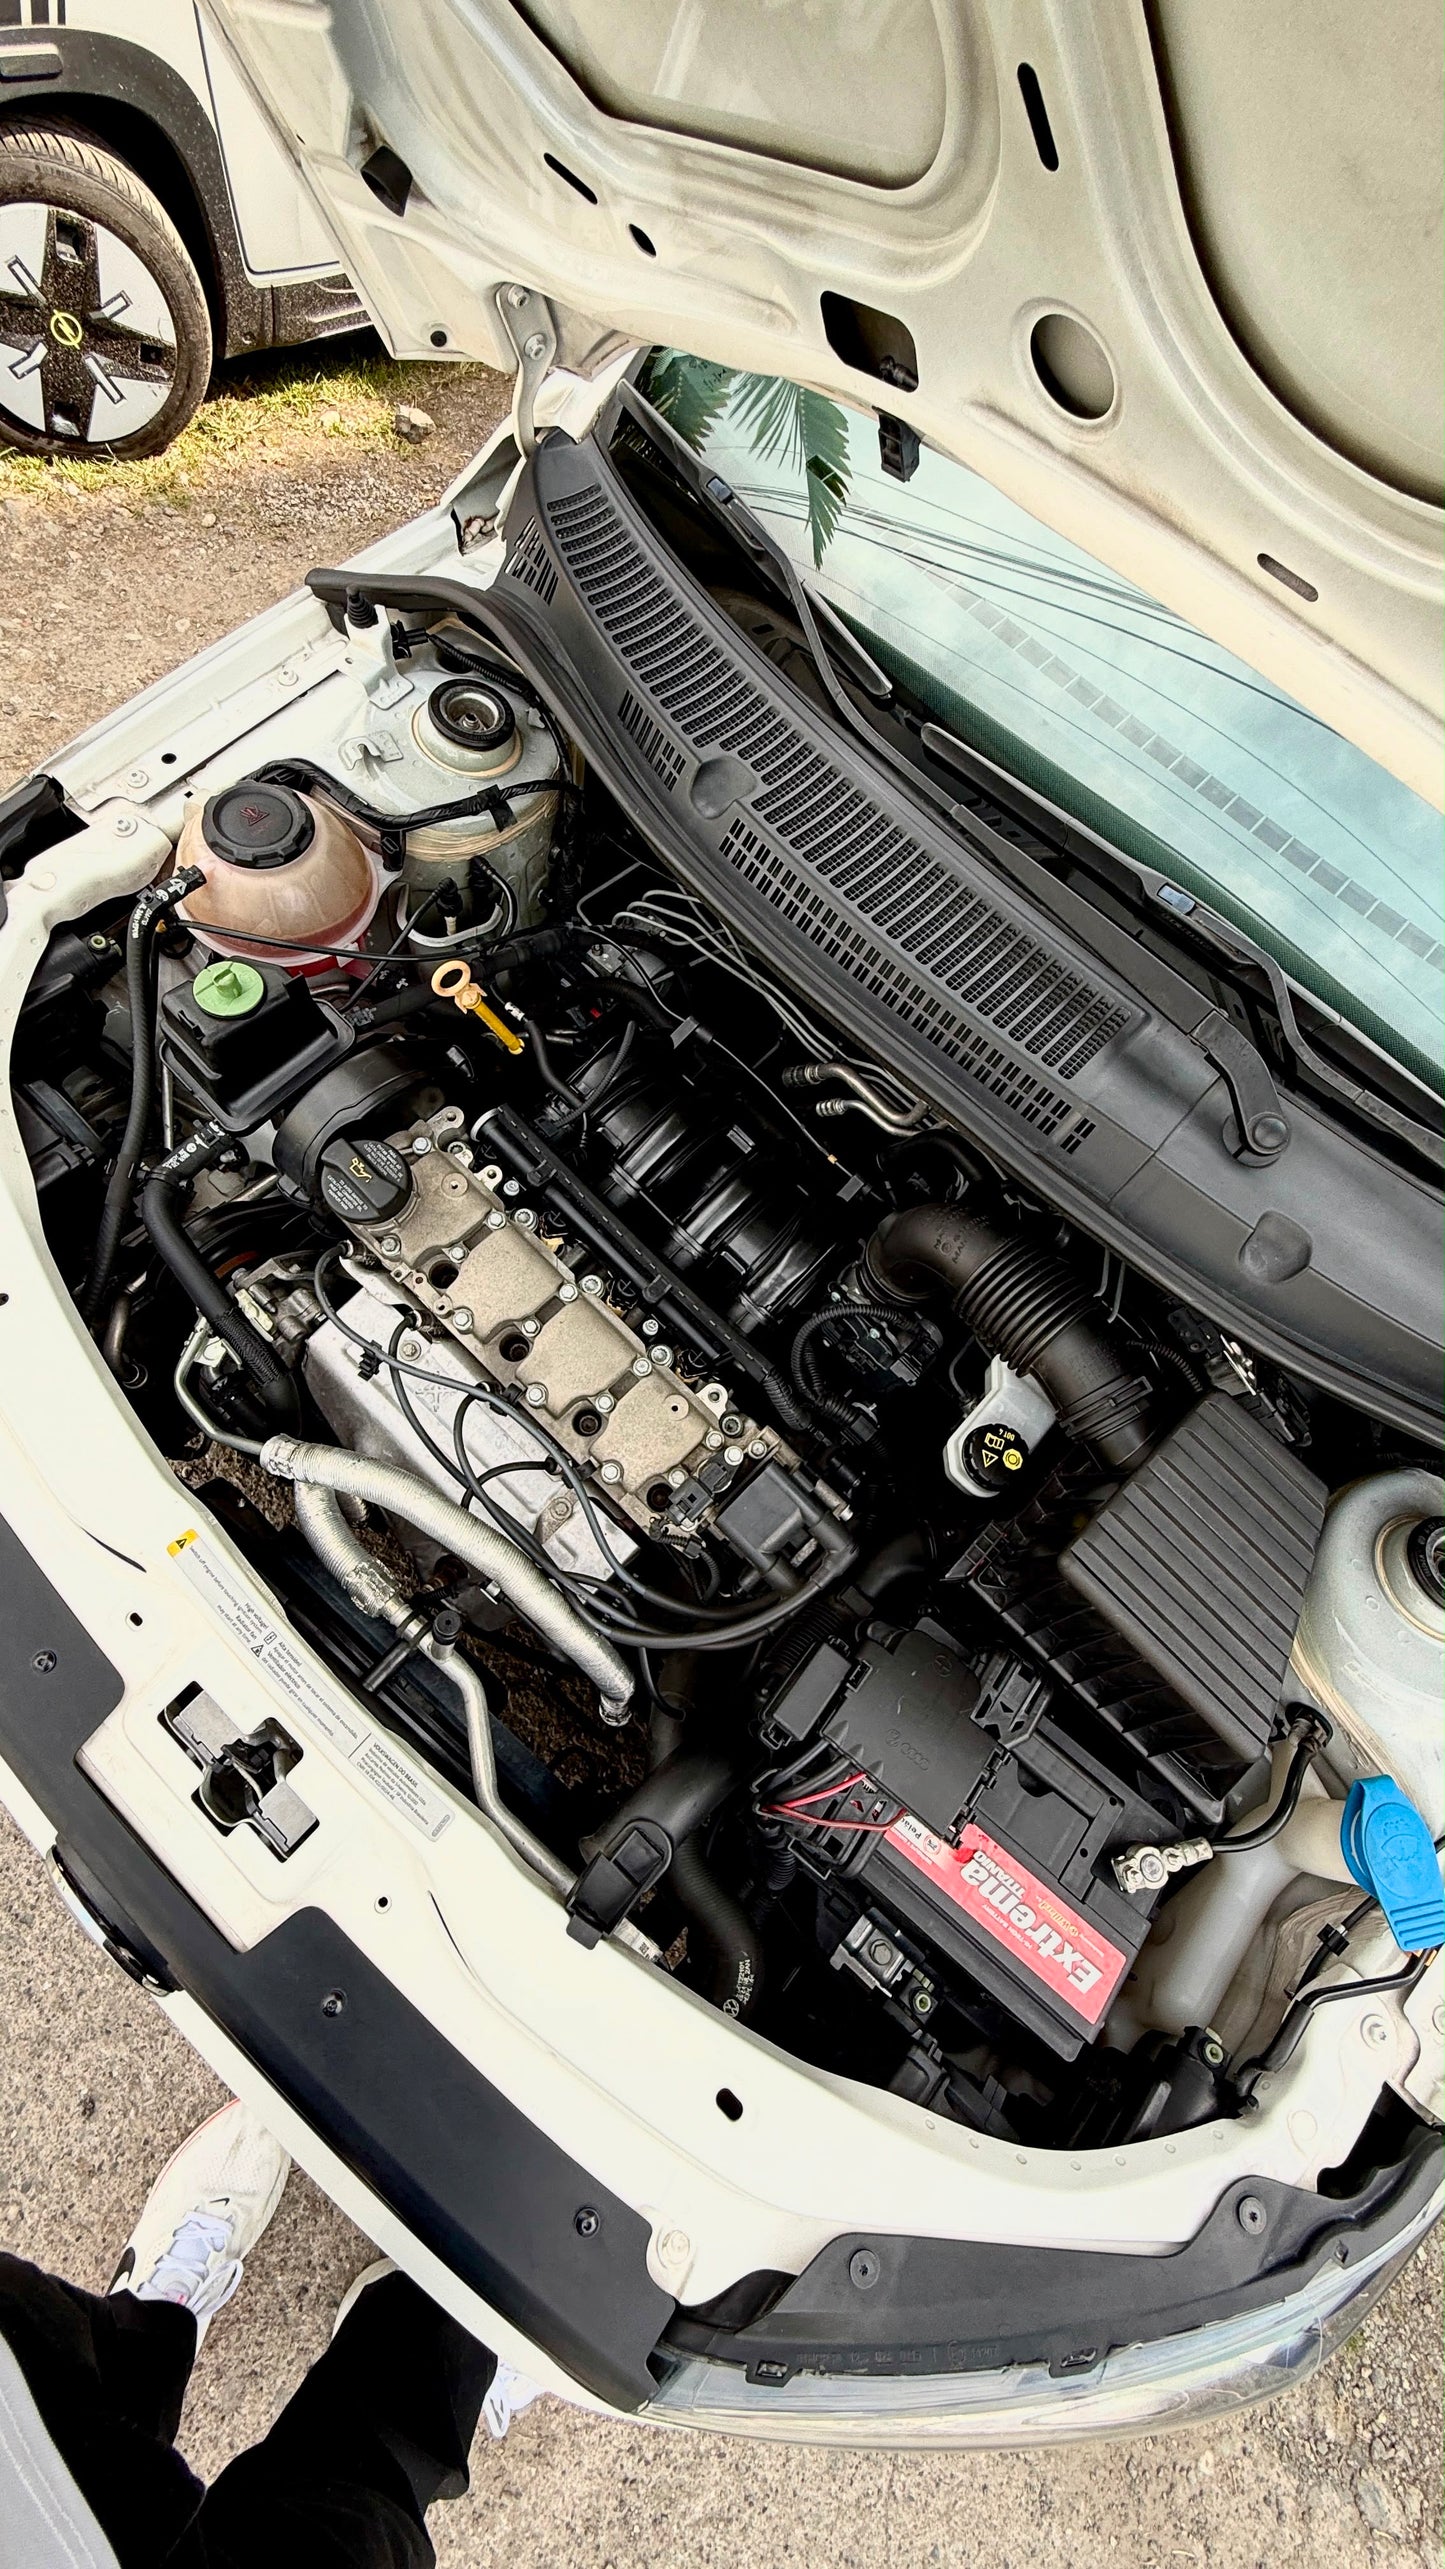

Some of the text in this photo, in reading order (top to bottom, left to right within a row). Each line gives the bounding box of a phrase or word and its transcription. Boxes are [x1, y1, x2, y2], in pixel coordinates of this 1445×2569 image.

[1003, 1431, 1015, 1441] DOT
[372, 1742, 400, 1768] VOLKSWAGEN
[404, 1773, 418, 1787] BRASIL
[971, 1847, 1027, 1899] TITANIO
[958, 1856, 1104, 1995] Extrema
[1037, 1898, 1073, 1932] Willard
